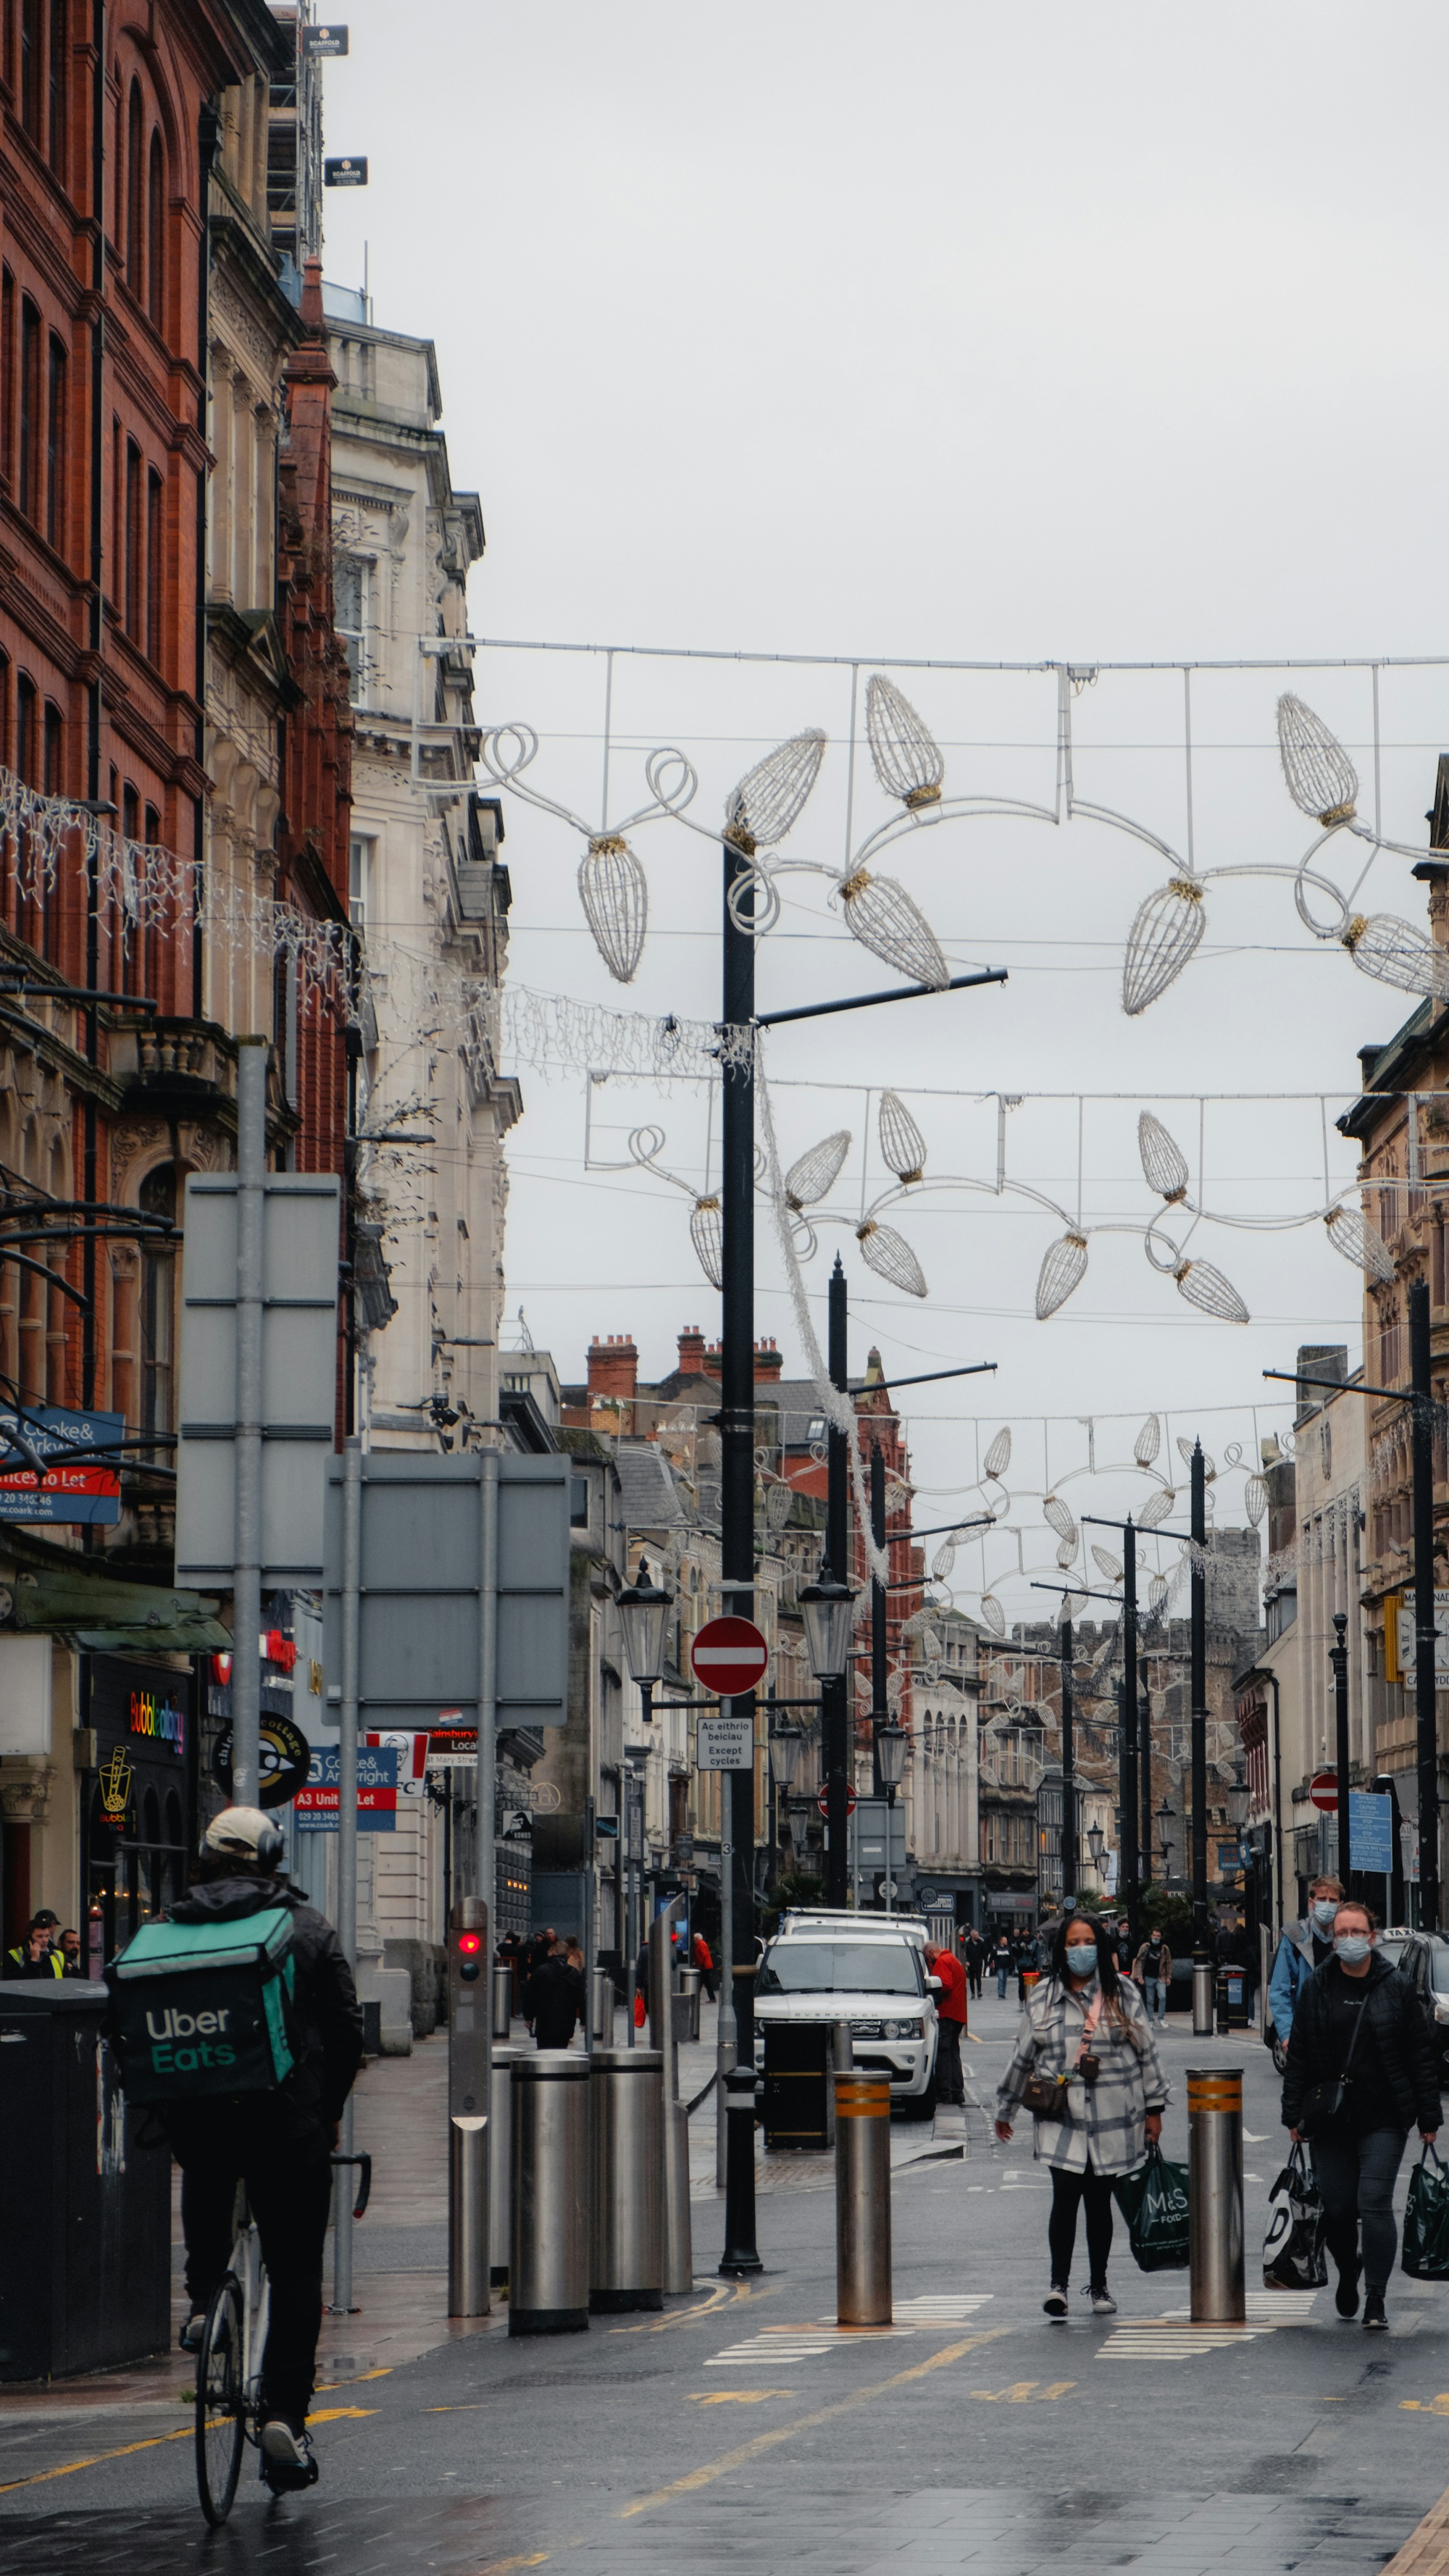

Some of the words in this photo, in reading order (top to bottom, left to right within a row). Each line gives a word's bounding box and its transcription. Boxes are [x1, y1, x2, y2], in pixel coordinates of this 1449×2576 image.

[62, 1471, 86, 1487] Let
[261, 1719, 301, 1756] cottage
[709, 1747, 742, 1755] Except
[710, 1757, 740, 1766] cycles
[325, 1769, 389, 1786] Arright
[297, 1793, 312, 1805] A3
[316, 1793, 338, 1805] Unit
[357, 1794, 375, 1805] Let
[298, 1812, 312, 1821] 029
[313, 1812, 322, 1821] 20
[146, 2007, 230, 2041] Uber
[151, 2041, 237, 2074] Eats
[1147, 2188, 1189, 2214] M&S
